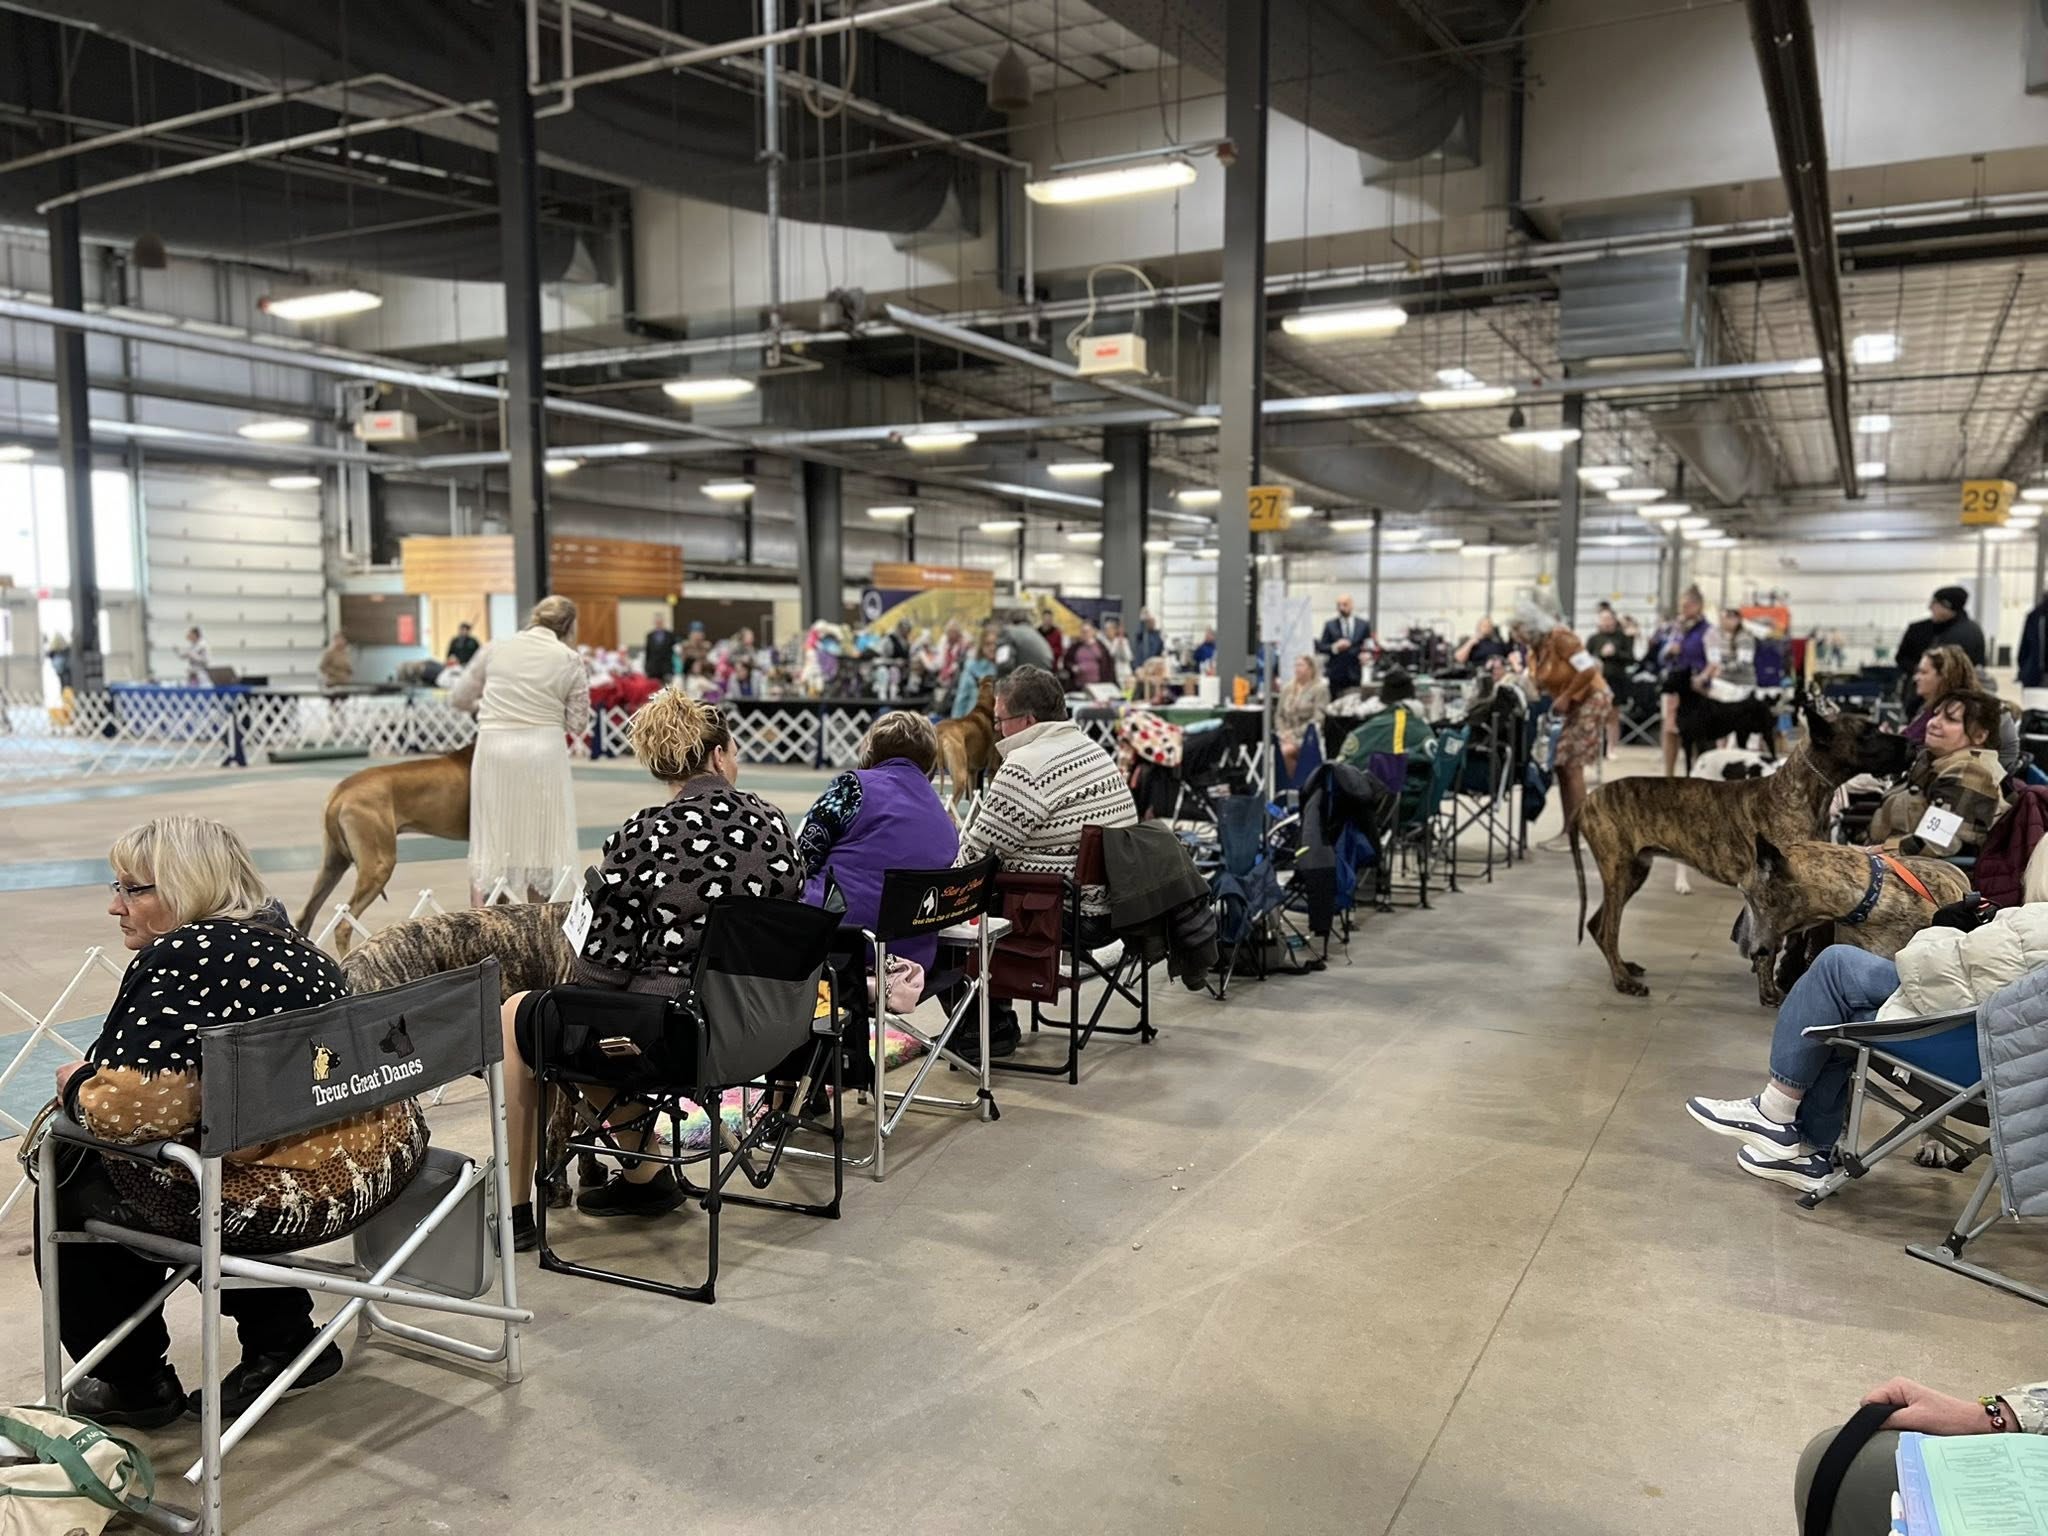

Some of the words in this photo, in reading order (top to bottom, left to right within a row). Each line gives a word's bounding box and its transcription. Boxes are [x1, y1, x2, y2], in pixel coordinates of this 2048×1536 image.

[1249, 495, 1278, 519] 27
[1964, 489, 1999, 512] 29
[1926, 816, 1942, 831] 59
[312, 1082, 349, 1106] Treue
[350, 1069, 382, 1095] Great
[380, 1058, 424, 1085] Danes
